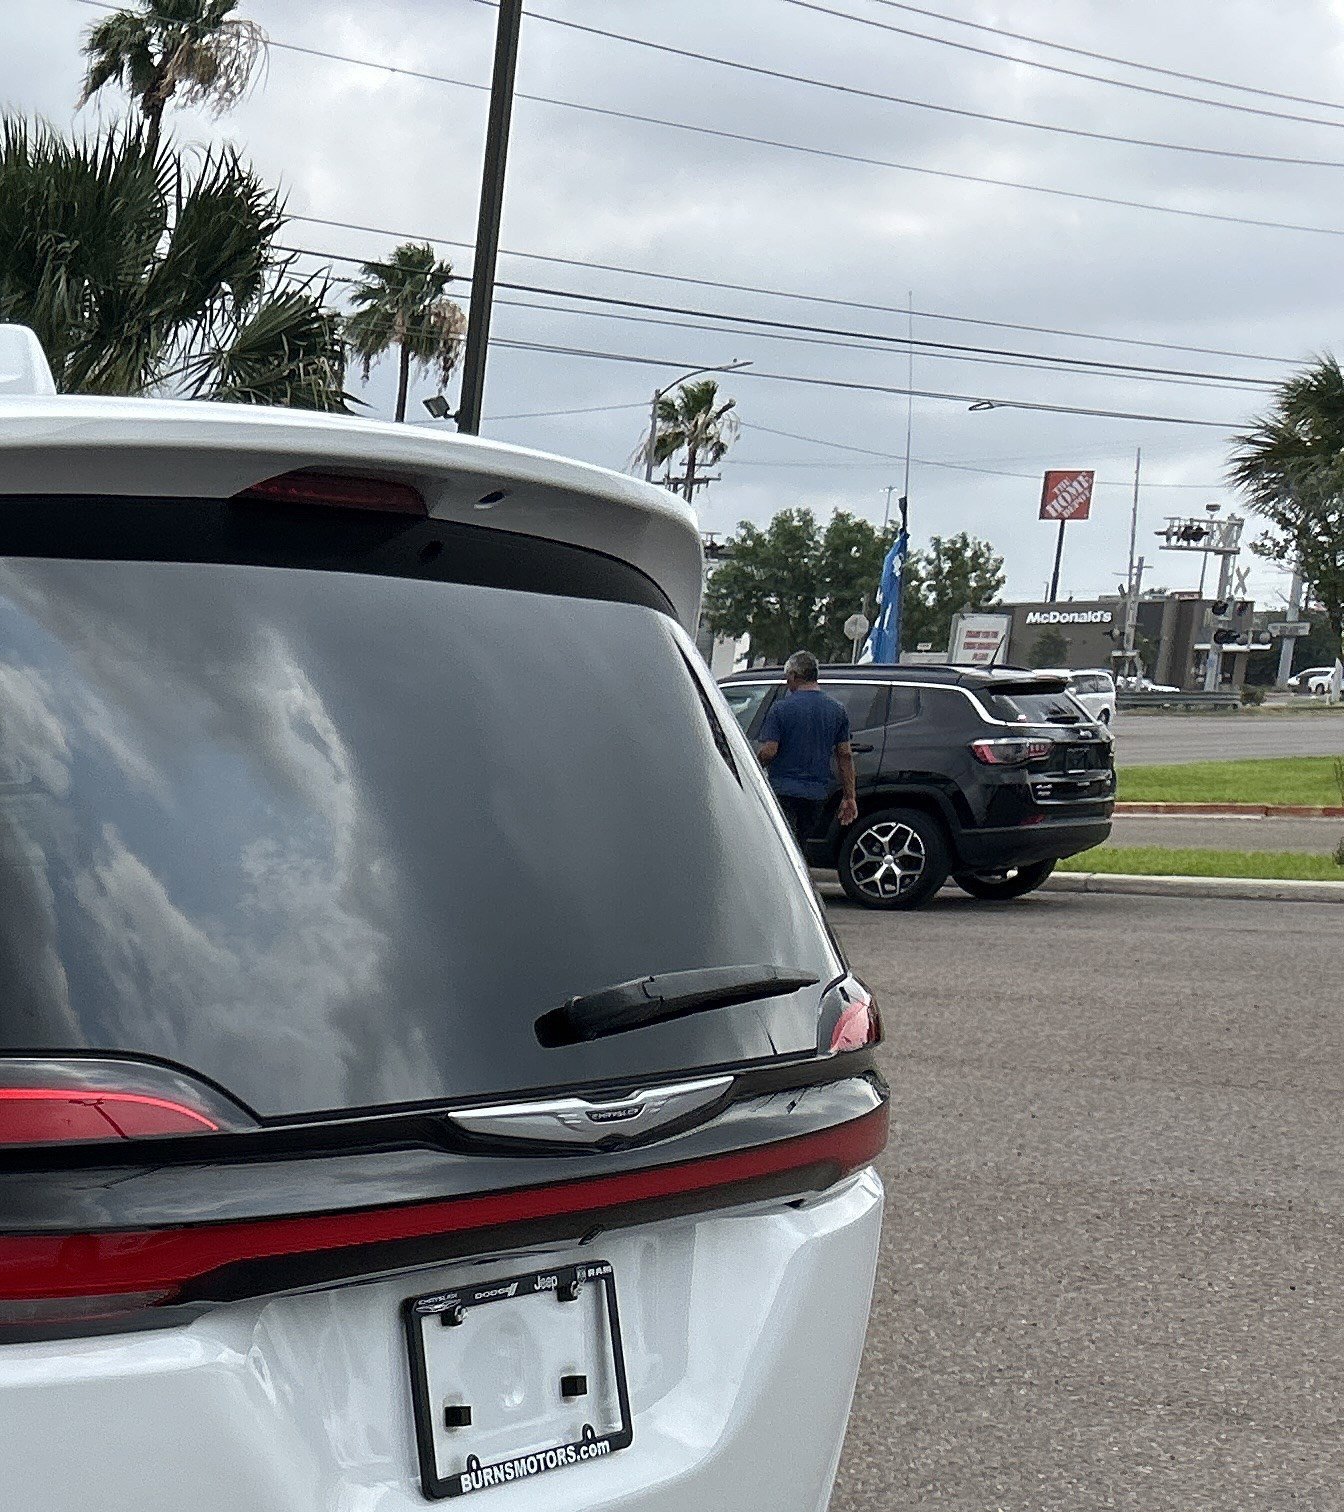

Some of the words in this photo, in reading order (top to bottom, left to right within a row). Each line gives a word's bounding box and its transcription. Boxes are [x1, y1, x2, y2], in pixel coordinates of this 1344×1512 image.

[1025, 610, 1112, 624] McDonald's
[534, 1275, 558, 1290] Jeep
[588, 1265, 612, 1278] RAM
[460, 1439, 611, 1493] BURNSMOTORS.com
